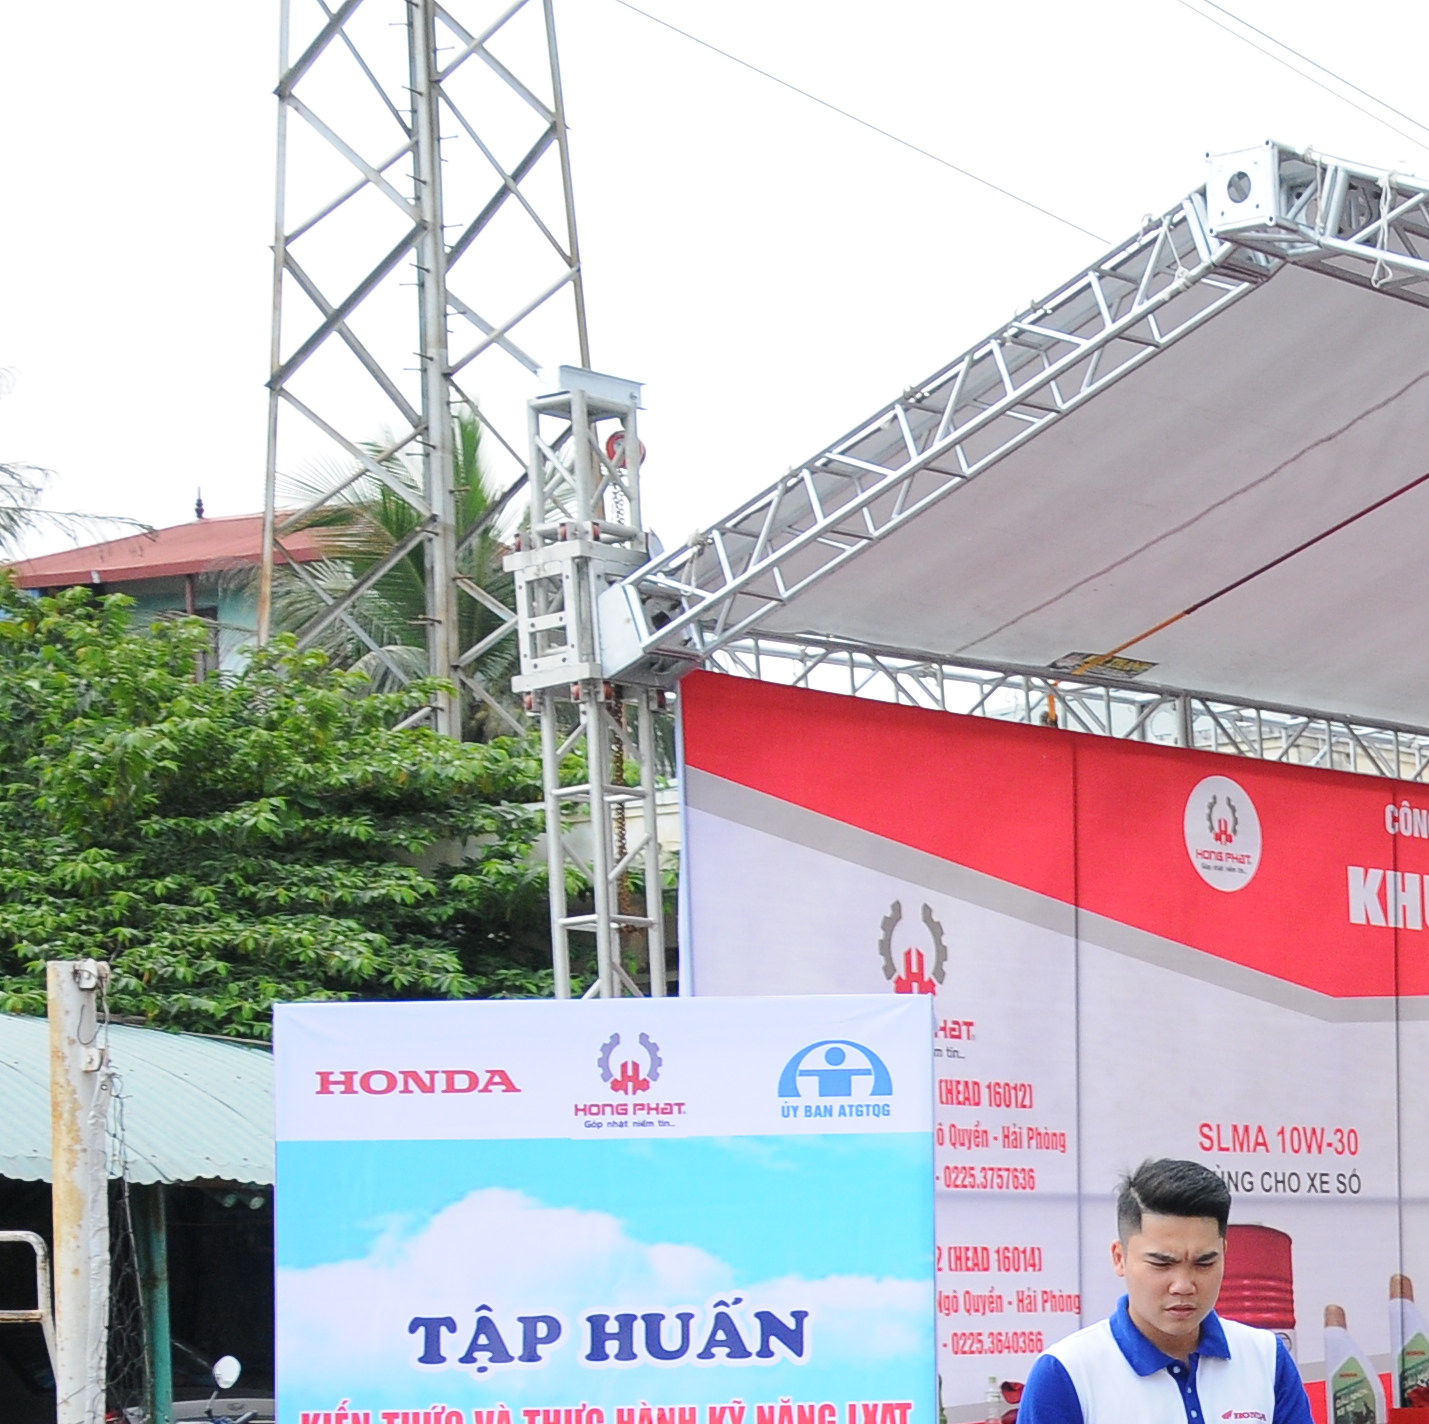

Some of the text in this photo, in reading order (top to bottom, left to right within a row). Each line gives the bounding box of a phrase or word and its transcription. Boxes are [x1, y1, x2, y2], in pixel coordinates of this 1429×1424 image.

[315, 1069, 522, 1095] HONDA
[804, 1105, 833, 1118] BAN
[838, 1103, 891, 1118] ATGTQG
[1002, 1122, 1067, 1153] Hải Phòng
[1198, 1122, 1359, 1156] SLMA 10W-30
[943, 1165, 1036, 1191] 0225.3757636
[1260, 1168, 1361, 1195] CHO XE SỐ
[1016, 1287, 1082, 1315] Hải Phòng
[408, 1296, 809, 1373] TẬP HUẤN
[951, 1331, 1045, 1355] 0225.3640366
